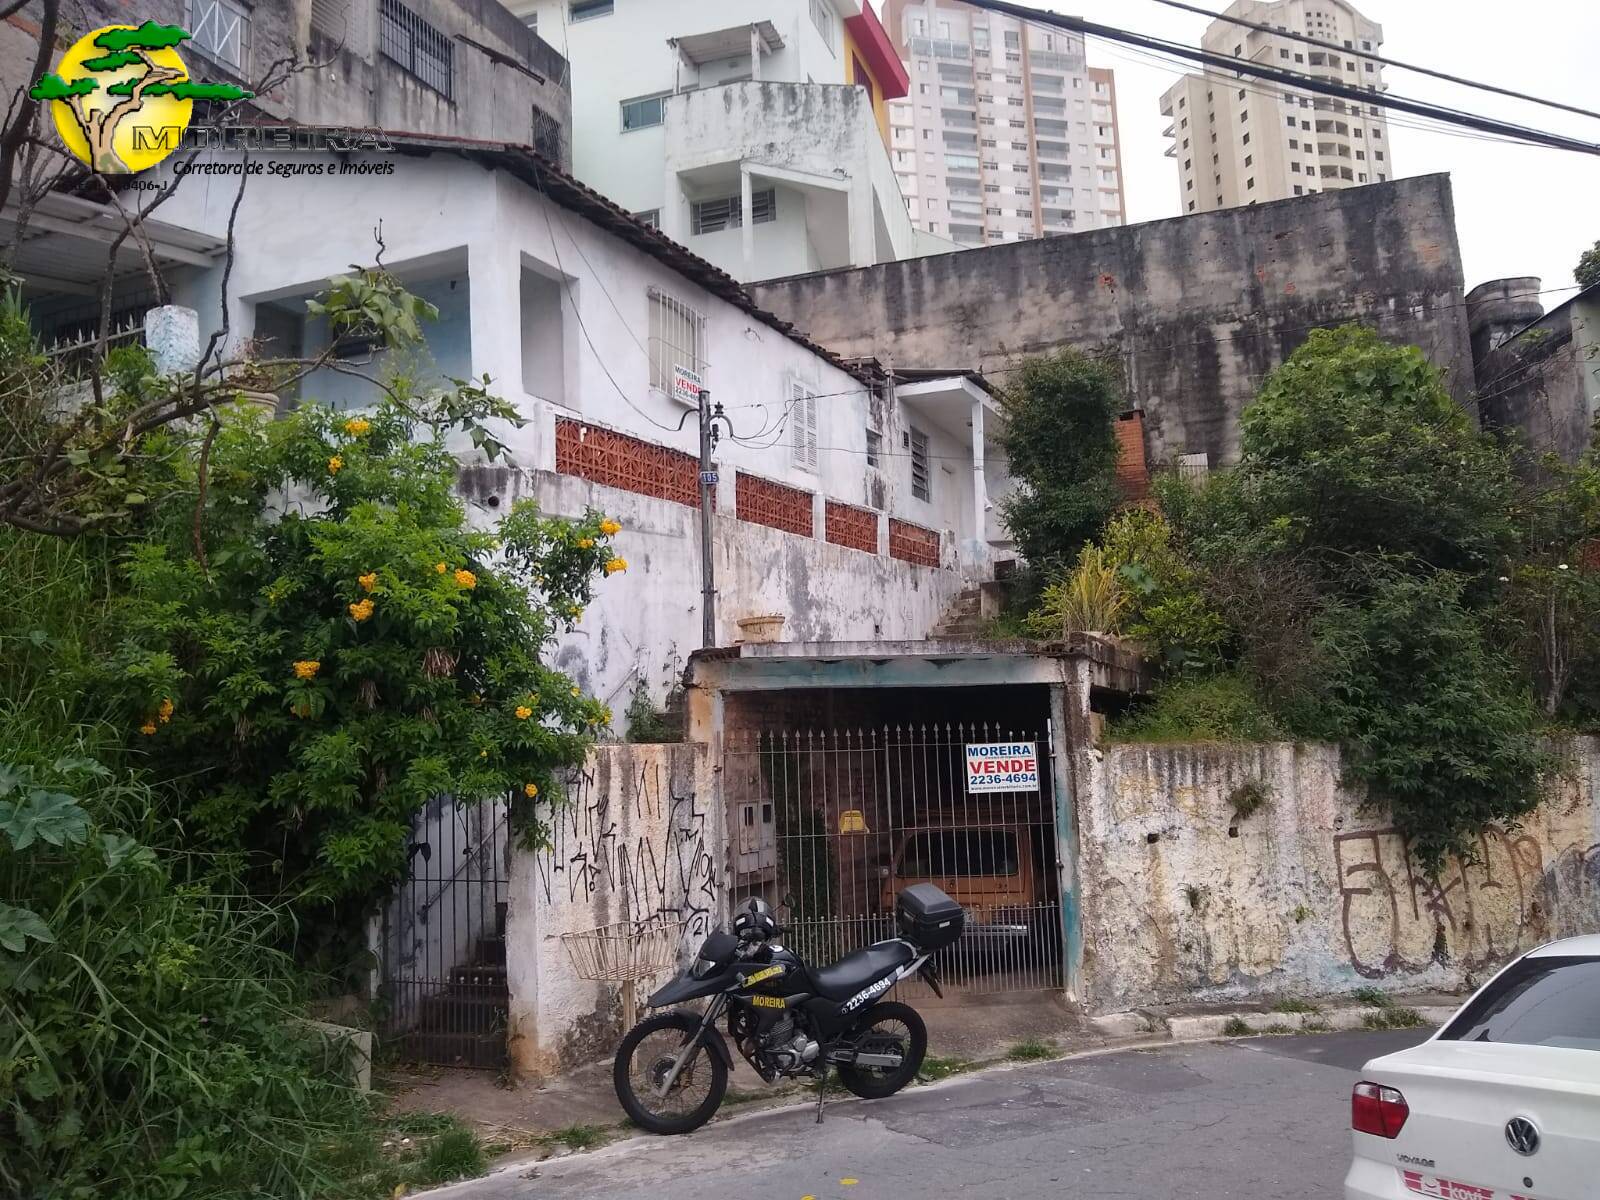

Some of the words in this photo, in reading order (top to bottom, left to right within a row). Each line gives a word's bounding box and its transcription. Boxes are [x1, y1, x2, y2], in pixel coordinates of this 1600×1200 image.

[675, 366, 701, 383] MOREIRA
[702, 473, 718, 482] 105
[968, 745, 1031, 757] MOREIRA
[969, 759, 1036, 774] VENDE
[970, 773, 1037, 785] 2236-4694
[846, 977, 891, 1010] 2236-4694
[752, 995, 786, 1009] MOREIRA
[1396, 1153, 1436, 1168] VOYAGE
